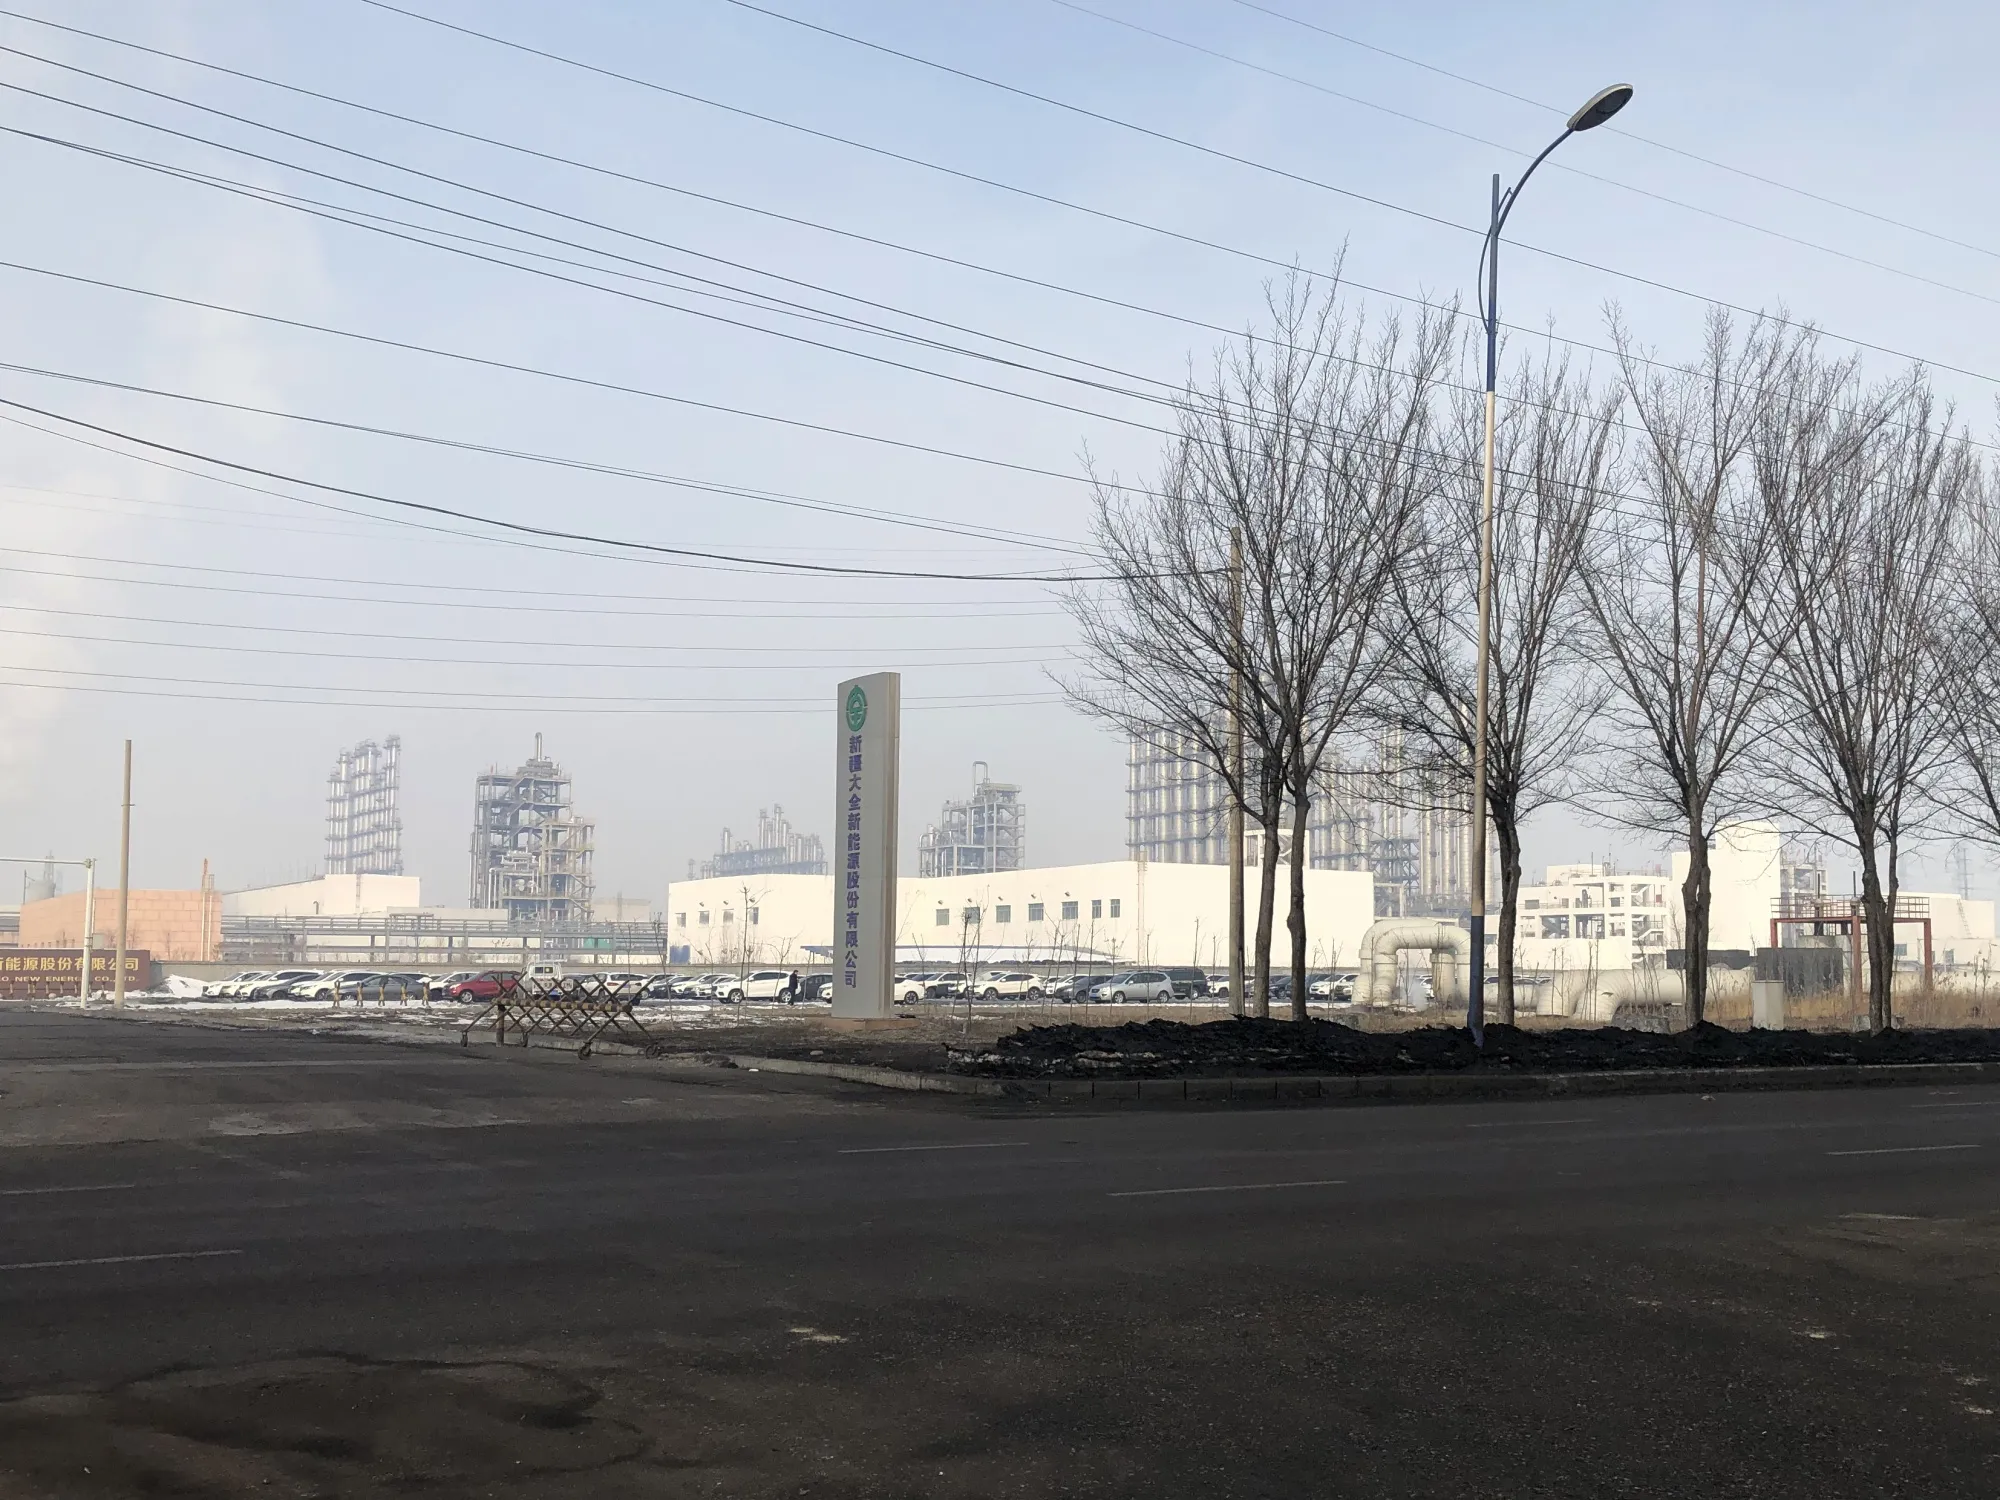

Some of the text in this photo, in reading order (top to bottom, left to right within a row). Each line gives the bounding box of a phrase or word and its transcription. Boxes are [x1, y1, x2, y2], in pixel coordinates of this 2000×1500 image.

[845, 735, 862, 988] 新疆大全新能源股份有限公司
[0, 957, 139, 971] 能源股份有限公司
